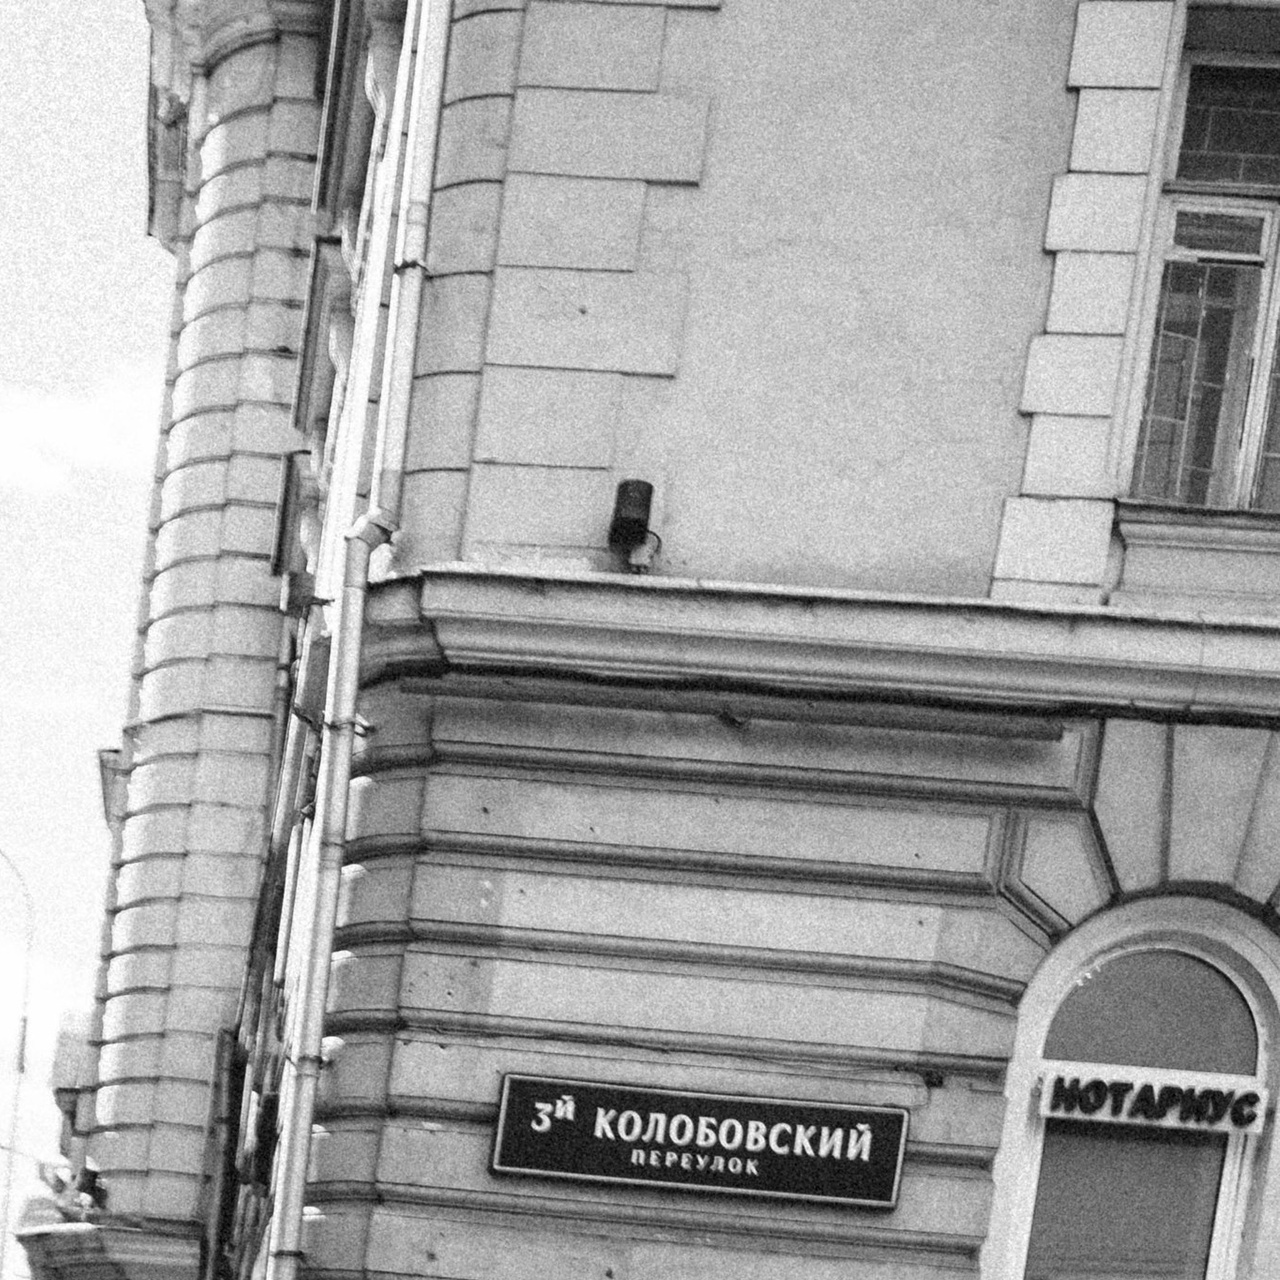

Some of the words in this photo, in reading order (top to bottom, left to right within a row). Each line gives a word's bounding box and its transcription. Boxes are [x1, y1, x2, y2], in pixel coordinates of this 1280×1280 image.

[1051, 1076, 1260, 1127] НОТАРИУС
[594, 1107, 872, 1161] КОЛОБОВСКИЙ
[631, 1149, 759, 1175] ПЕРЕУЛОК
